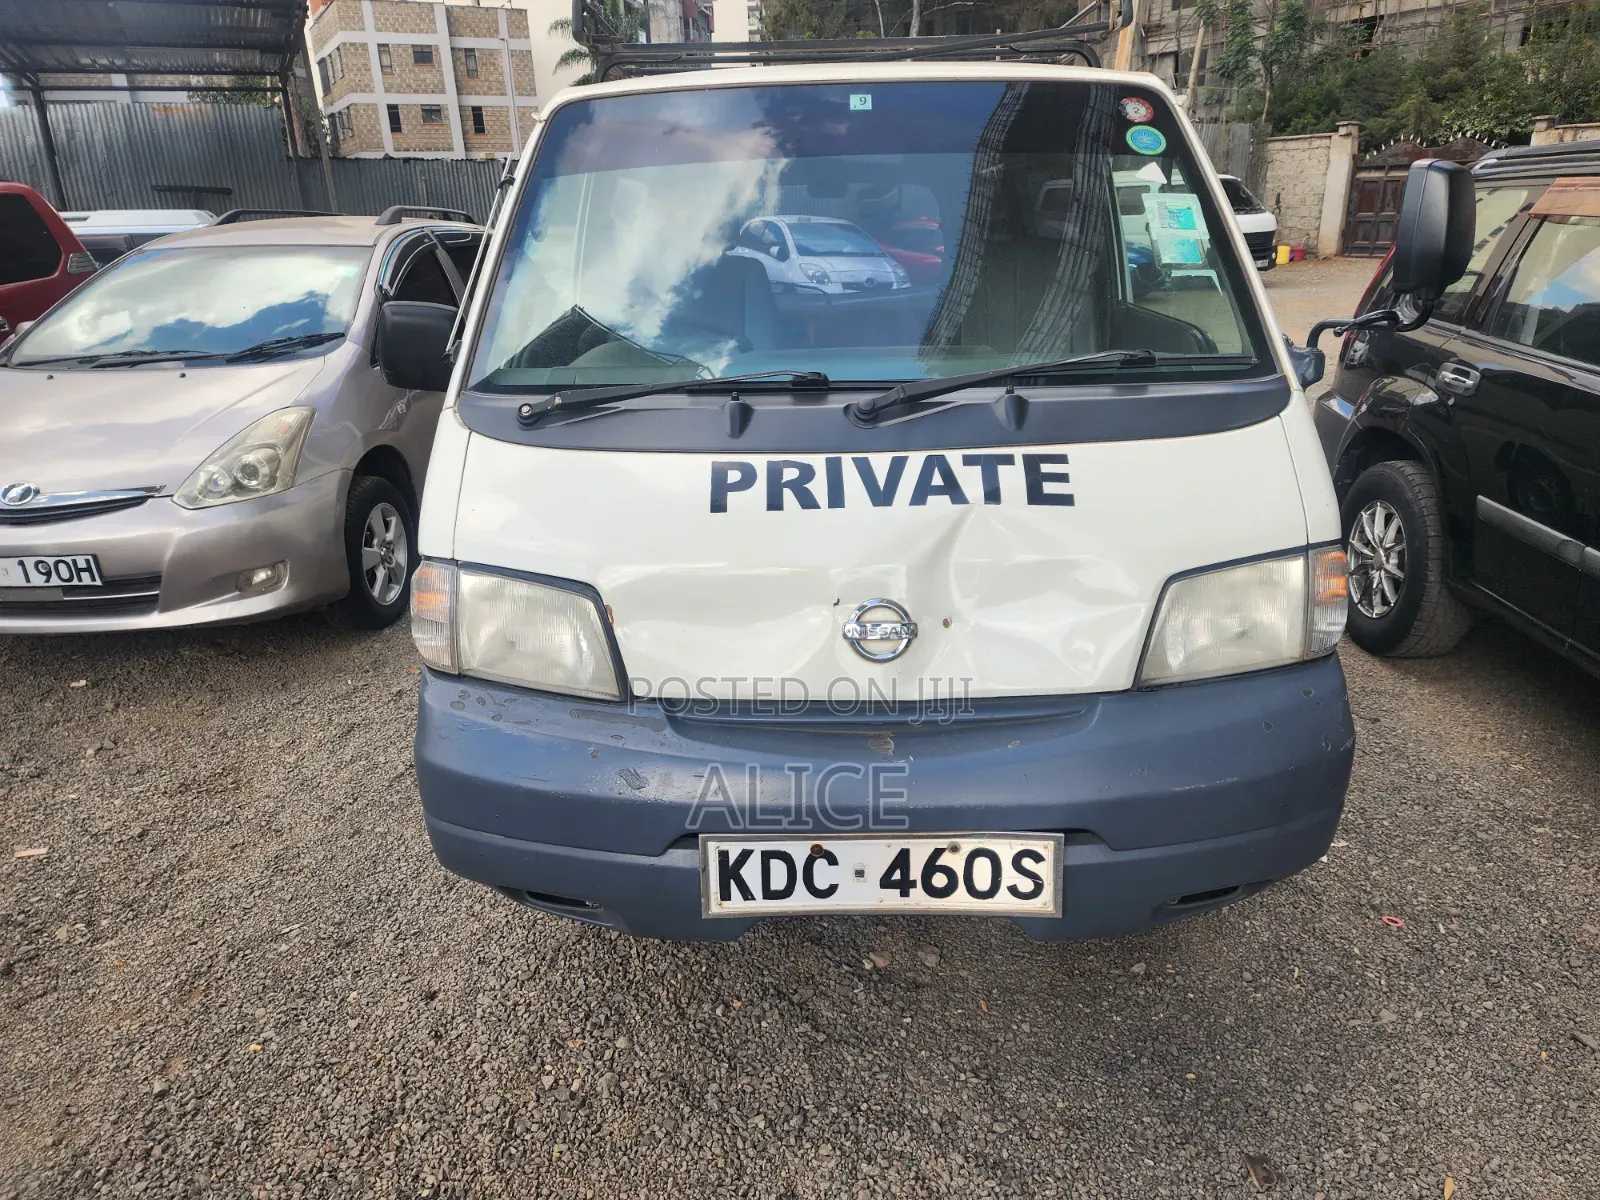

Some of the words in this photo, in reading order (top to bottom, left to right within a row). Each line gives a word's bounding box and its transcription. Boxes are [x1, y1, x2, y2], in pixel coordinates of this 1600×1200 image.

[710, 454, 1075, 513] PRIVATE
[17, 558, 96, 583] 190H
[851, 626, 910, 637] NISSAN
[717, 849, 839, 901] KDC
[879, 848, 1047, 900] 460S
